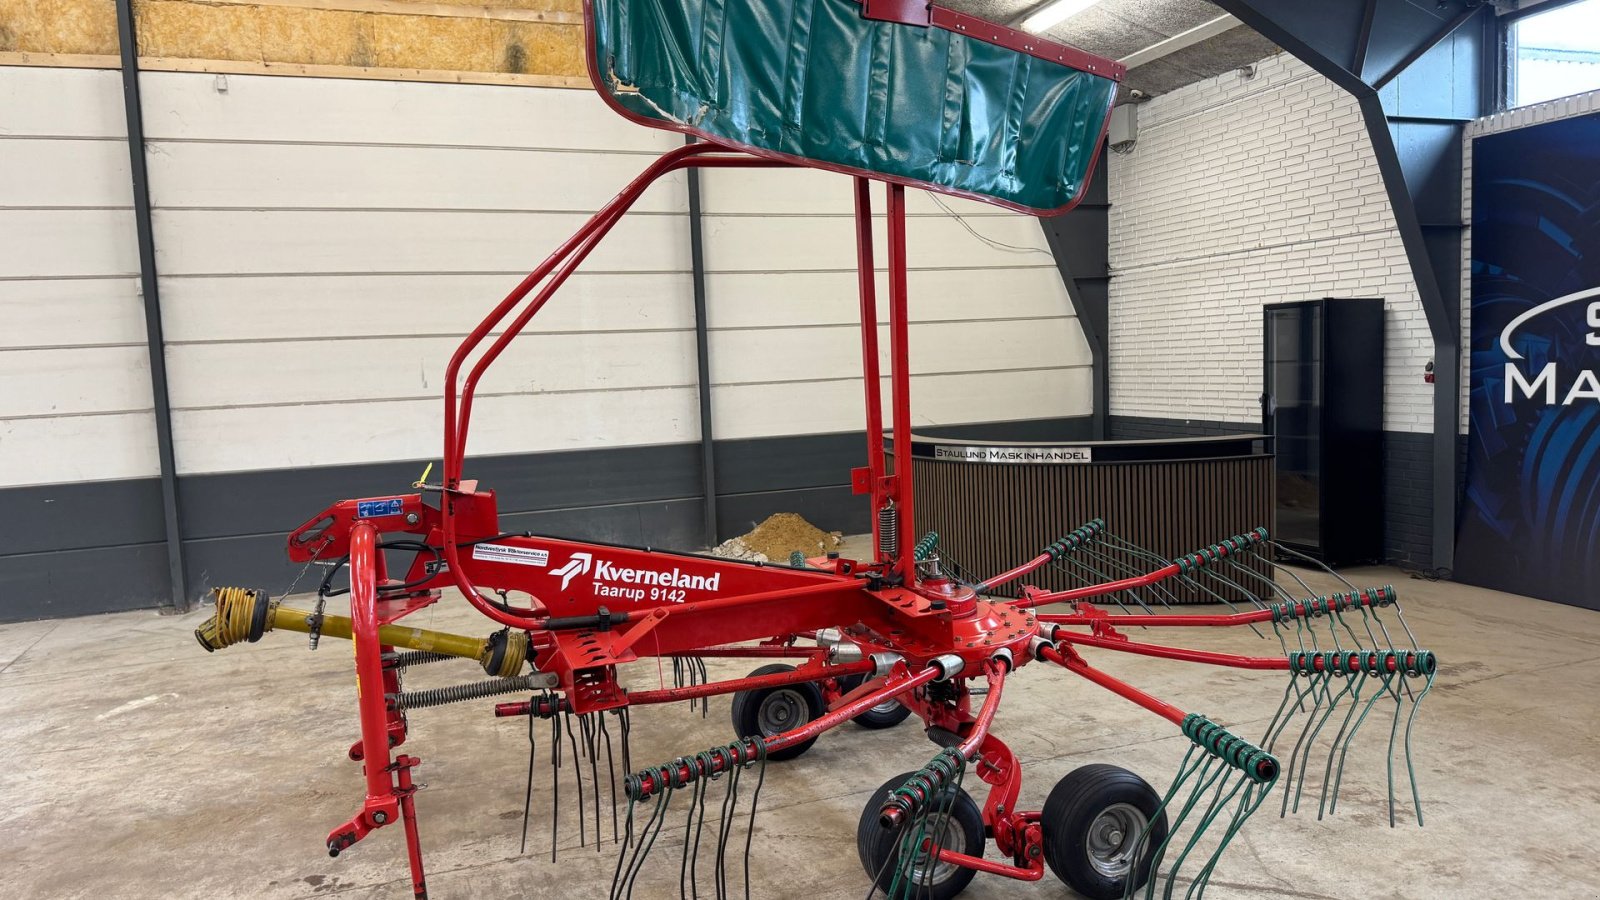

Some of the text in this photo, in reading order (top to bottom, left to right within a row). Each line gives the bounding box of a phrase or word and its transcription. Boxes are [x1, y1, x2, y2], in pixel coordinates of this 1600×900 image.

[936, 448, 1089, 460] STAULUND MASKINHANDEL
[594, 560, 720, 591] Kverneland
[592, 582, 686, 603] Taarup 9142
